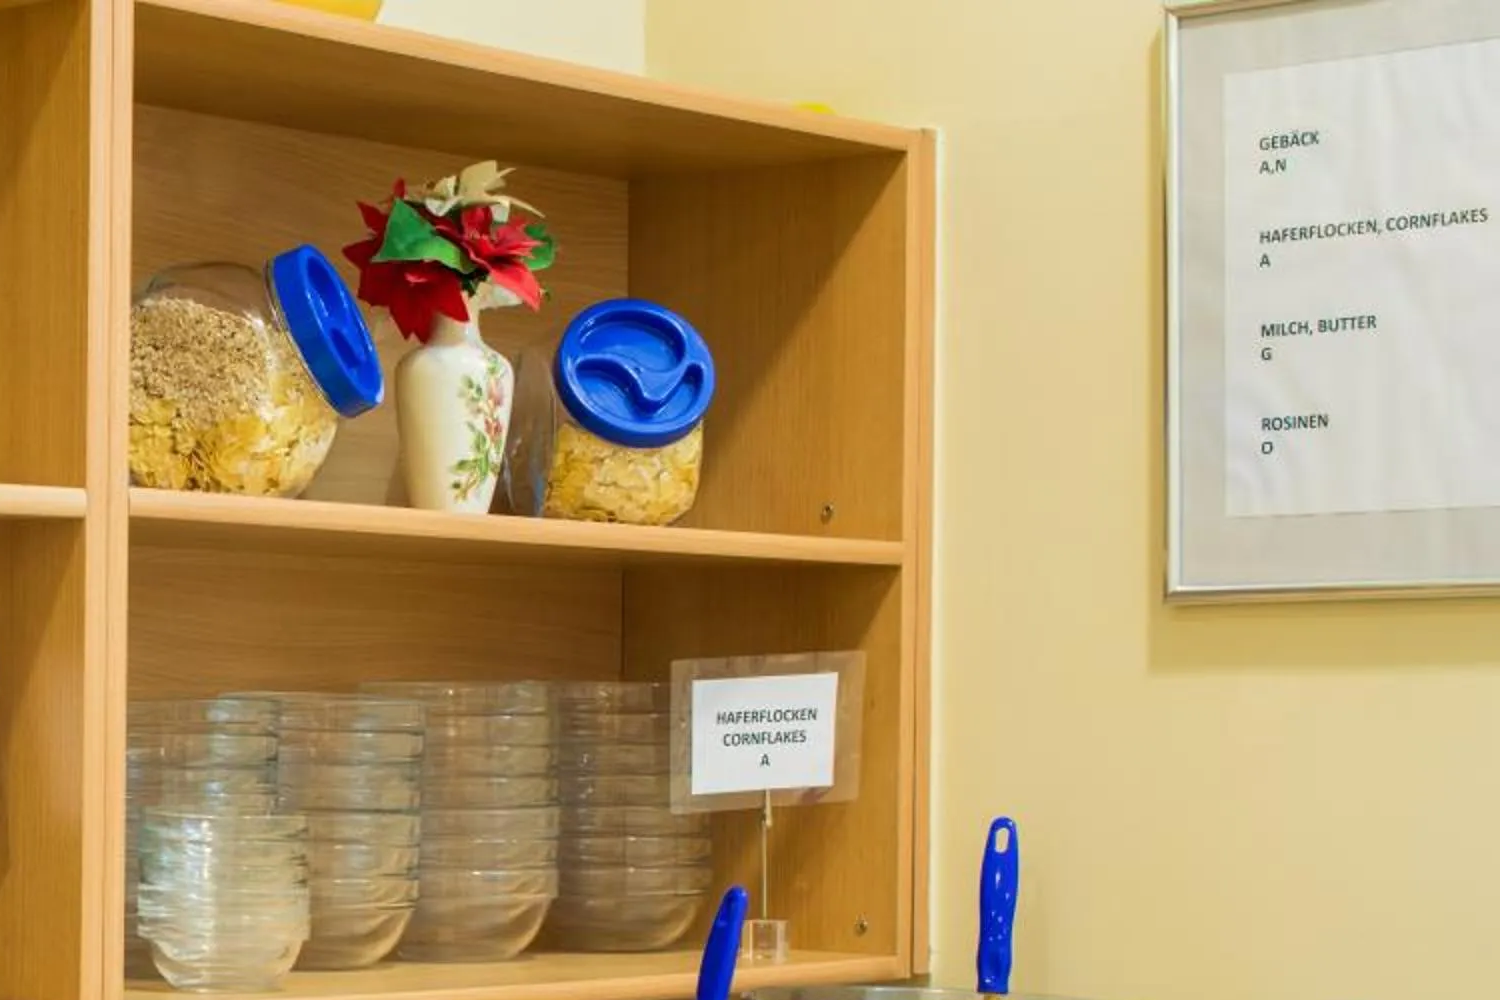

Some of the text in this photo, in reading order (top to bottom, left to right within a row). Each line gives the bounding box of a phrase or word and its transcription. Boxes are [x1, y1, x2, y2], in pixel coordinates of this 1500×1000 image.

[1259, 130, 1320, 151] GEBÄCK
[1259, 158, 1287, 174] A,N
[1259, 207, 1489, 244] HAFERFLOCKEN, CORNFLAKES
[1259, 253, 1271, 268] A
[1261, 314, 1377, 338] MILCH, BUTTER
[1261, 347, 1272, 361] G
[1261, 413, 1329, 431] ROSINEN
[1261, 441, 1273, 454] O
[716, 707, 818, 725] HAFERFLOCKEN
[723, 729, 807, 747] CORNFLAKES
[759, 753, 771, 767] A
